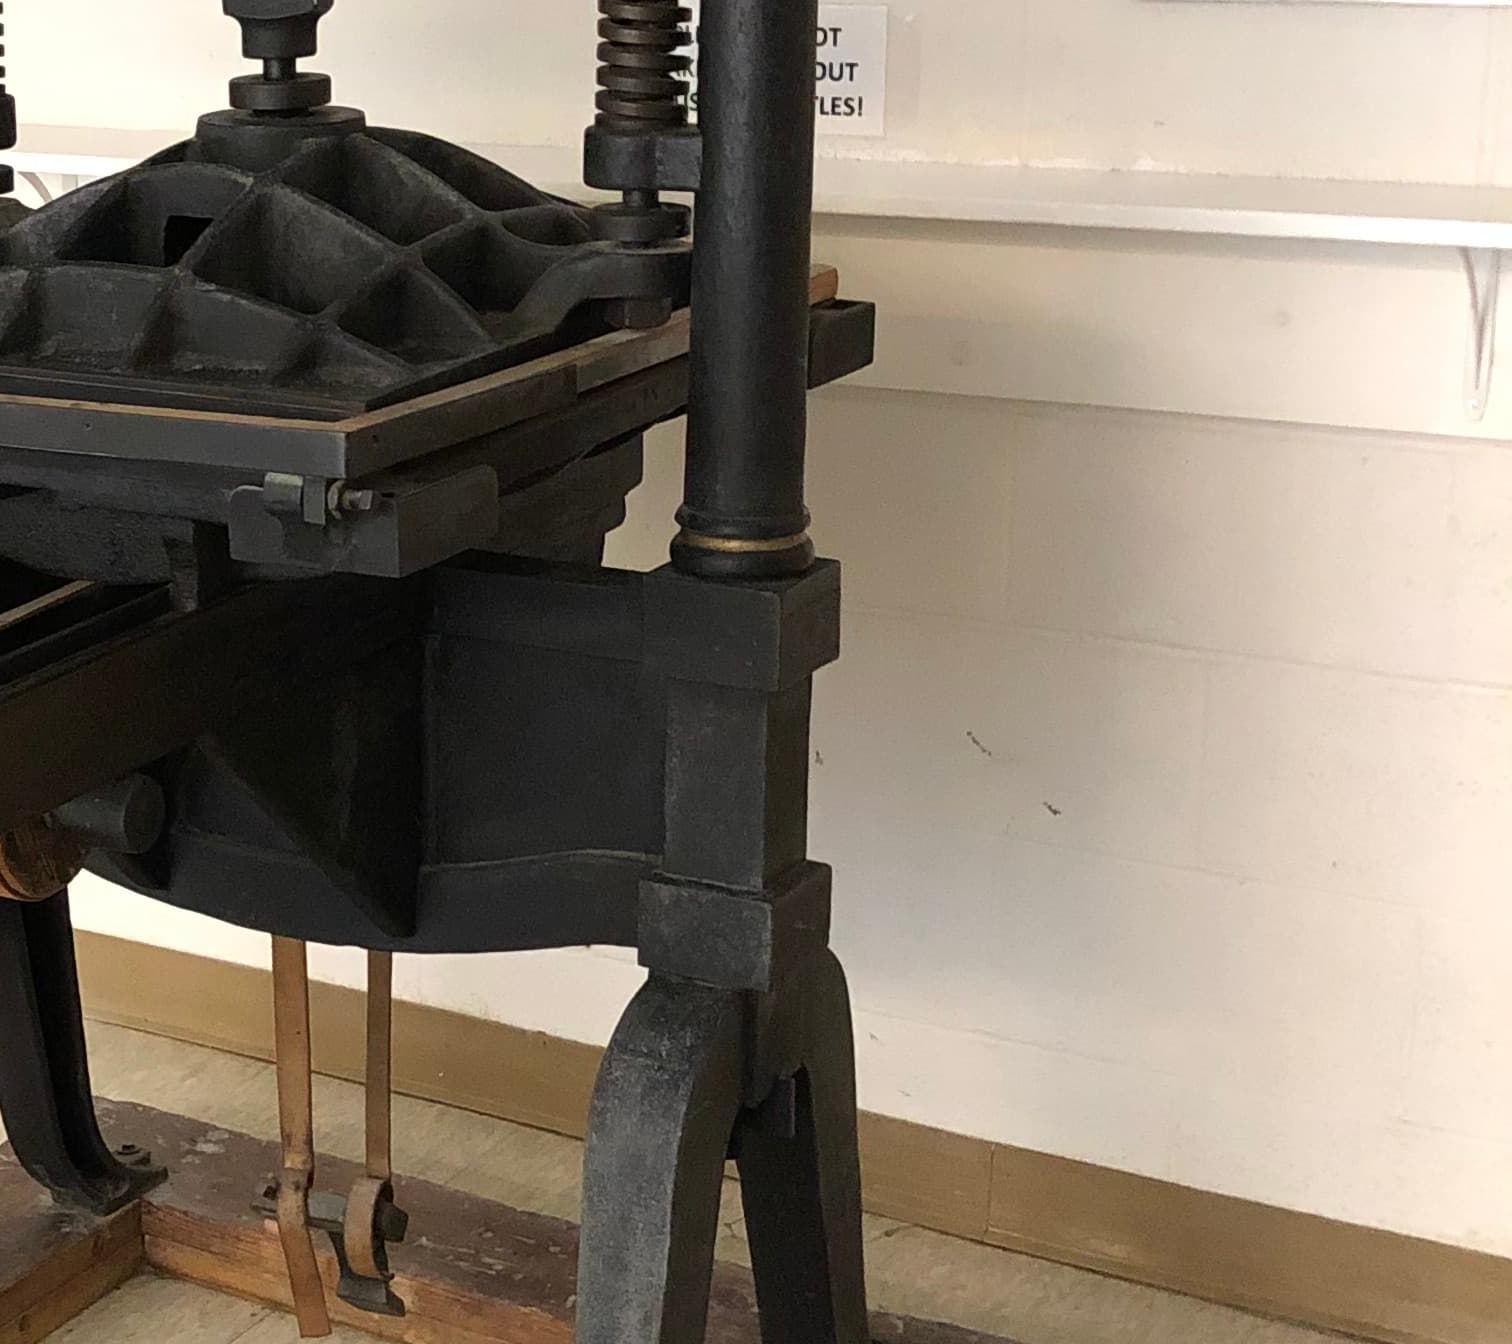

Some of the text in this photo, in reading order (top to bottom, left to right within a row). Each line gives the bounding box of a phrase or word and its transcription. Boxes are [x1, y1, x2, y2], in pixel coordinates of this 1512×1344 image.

[816, 27, 843, 47] OT
[815, 61, 859, 82] OUT
[814, 96, 864, 117] LES!
